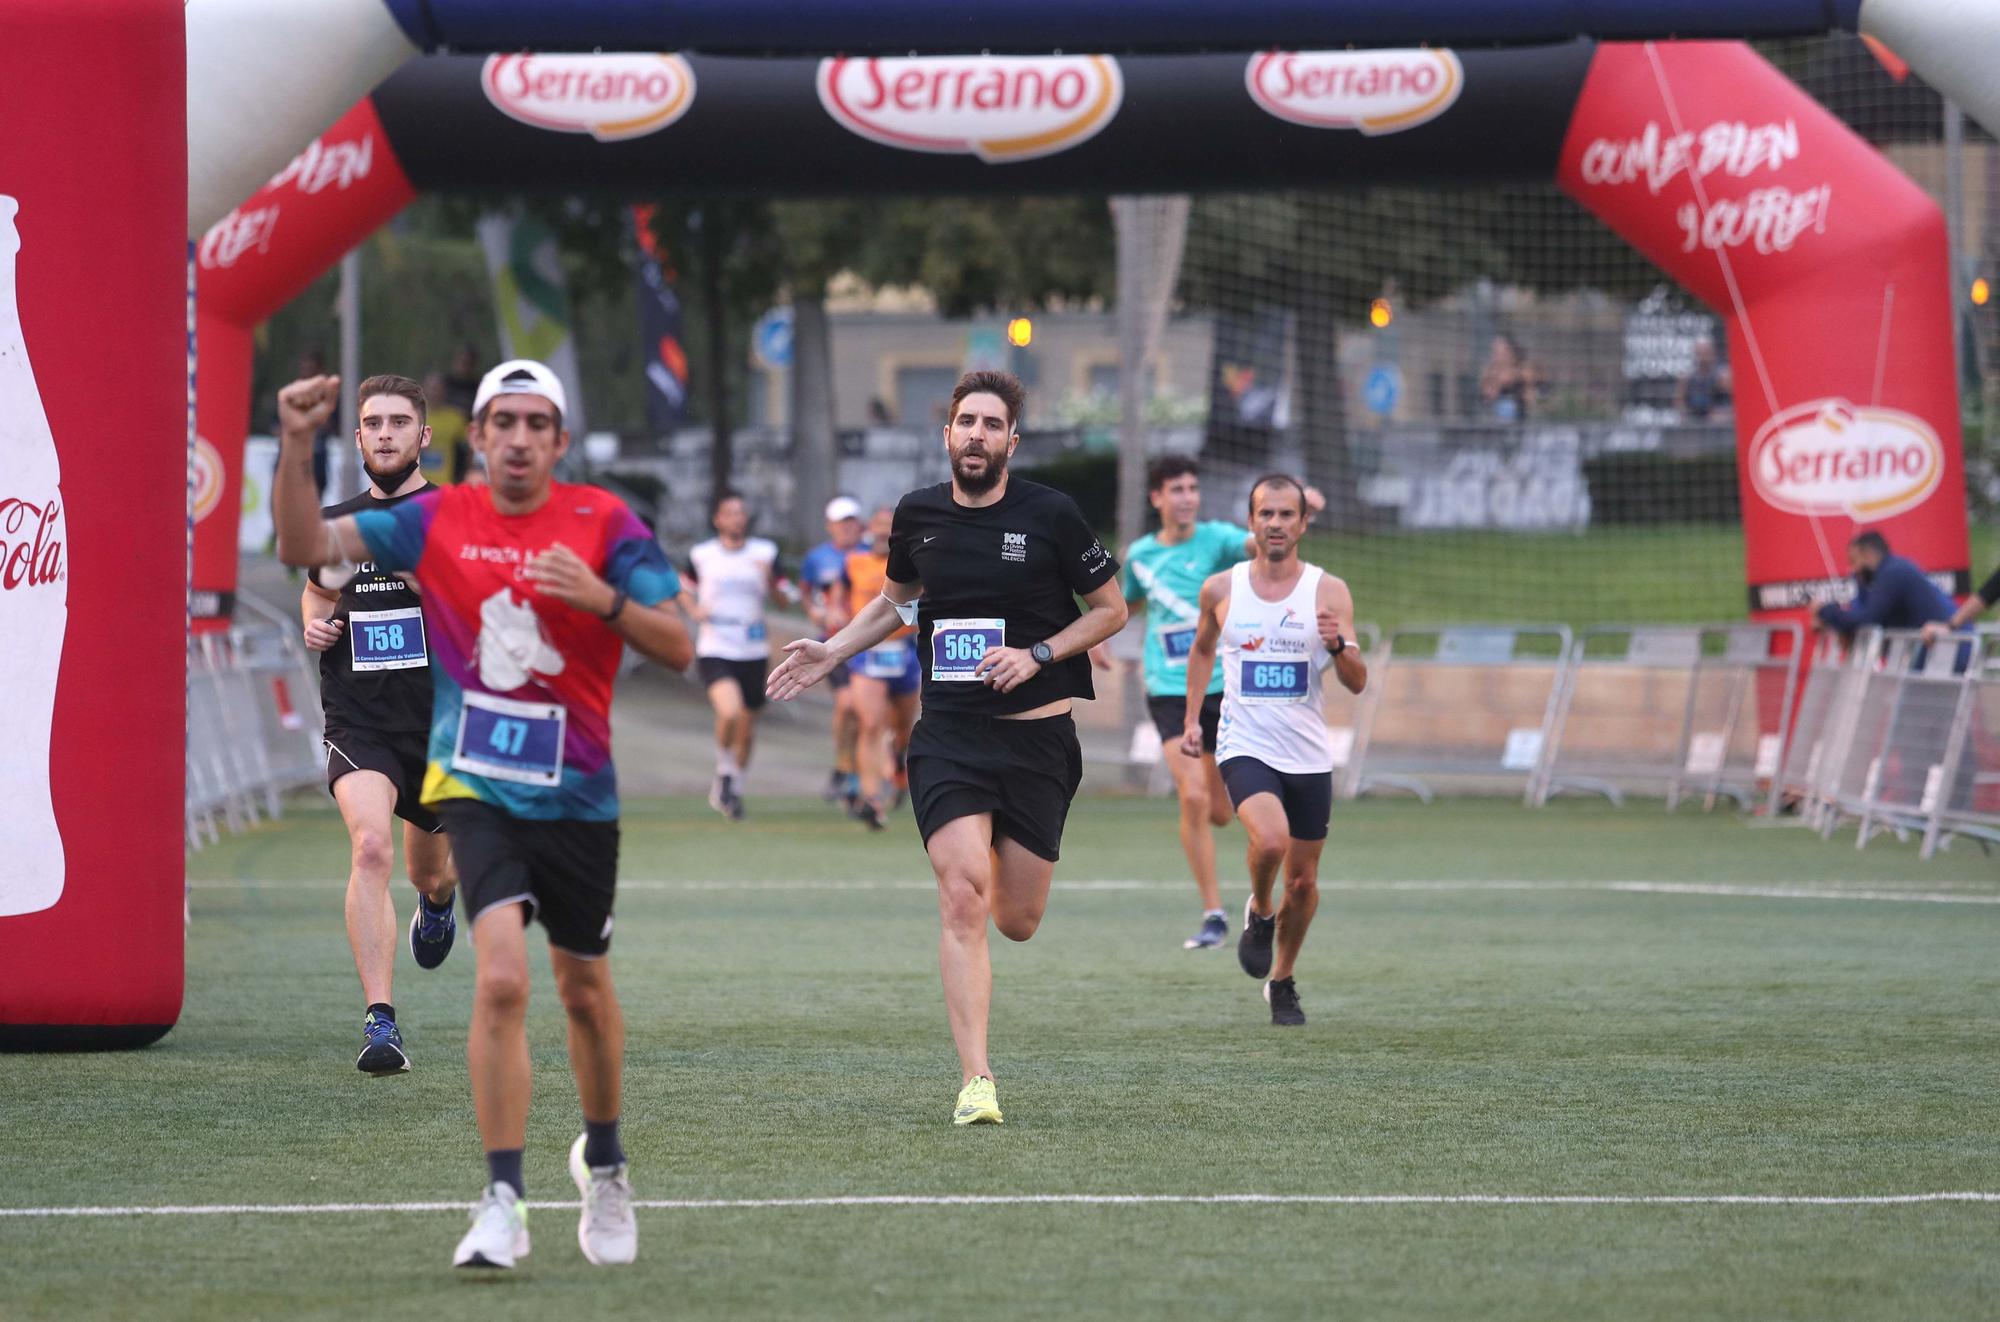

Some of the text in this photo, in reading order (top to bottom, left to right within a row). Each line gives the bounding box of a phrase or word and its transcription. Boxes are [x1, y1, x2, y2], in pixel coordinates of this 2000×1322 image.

[508, 53, 669, 101] Serrano
[860, 57, 1087, 111] Serrano
[1277, 52, 1438, 98] Serrano
[1769, 442, 1925, 485] Serrano
[0, 498, 62, 590] ola
[1004, 532, 1027, 545] 10K
[355, 581, 405, 593] BOMBERO
[364, 624, 405, 651] 758
[945, 634, 986, 660] 563
[1254, 665, 1296, 689] 656
[489, 717, 529, 756] 47
